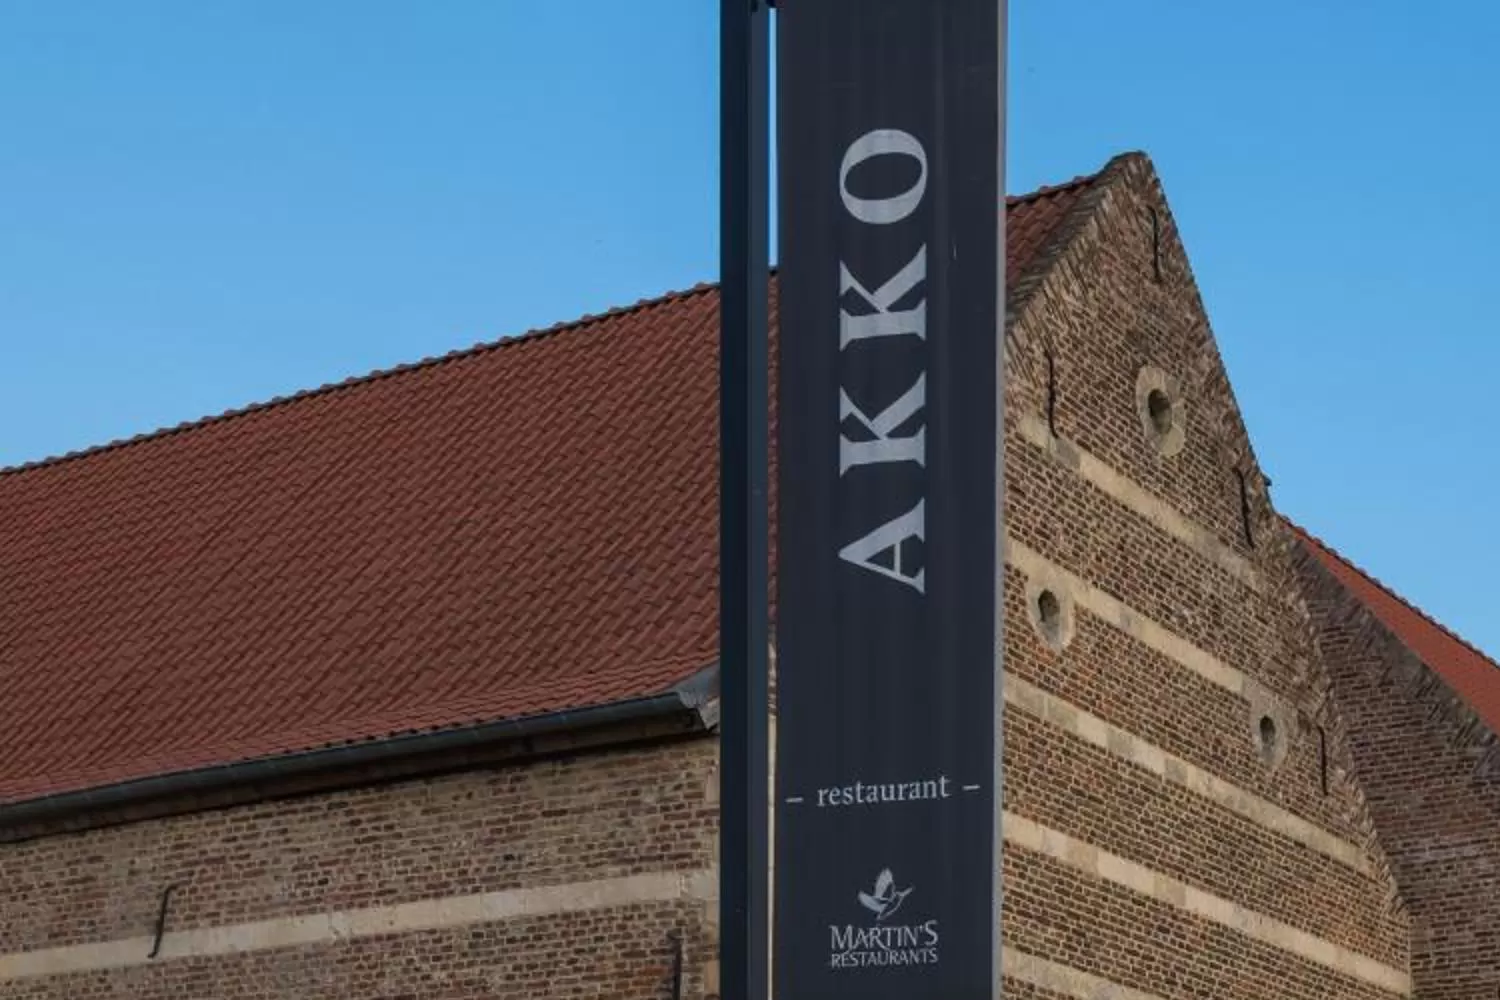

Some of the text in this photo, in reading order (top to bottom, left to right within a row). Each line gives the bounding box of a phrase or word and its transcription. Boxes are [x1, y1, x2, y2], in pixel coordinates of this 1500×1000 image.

[838, 129, 928, 594] AKKO
[817, 775, 951, 807] restaurant
[829, 920, 939, 951] MARTIN'S
[831, 948, 939, 968] RESTAURANTS
